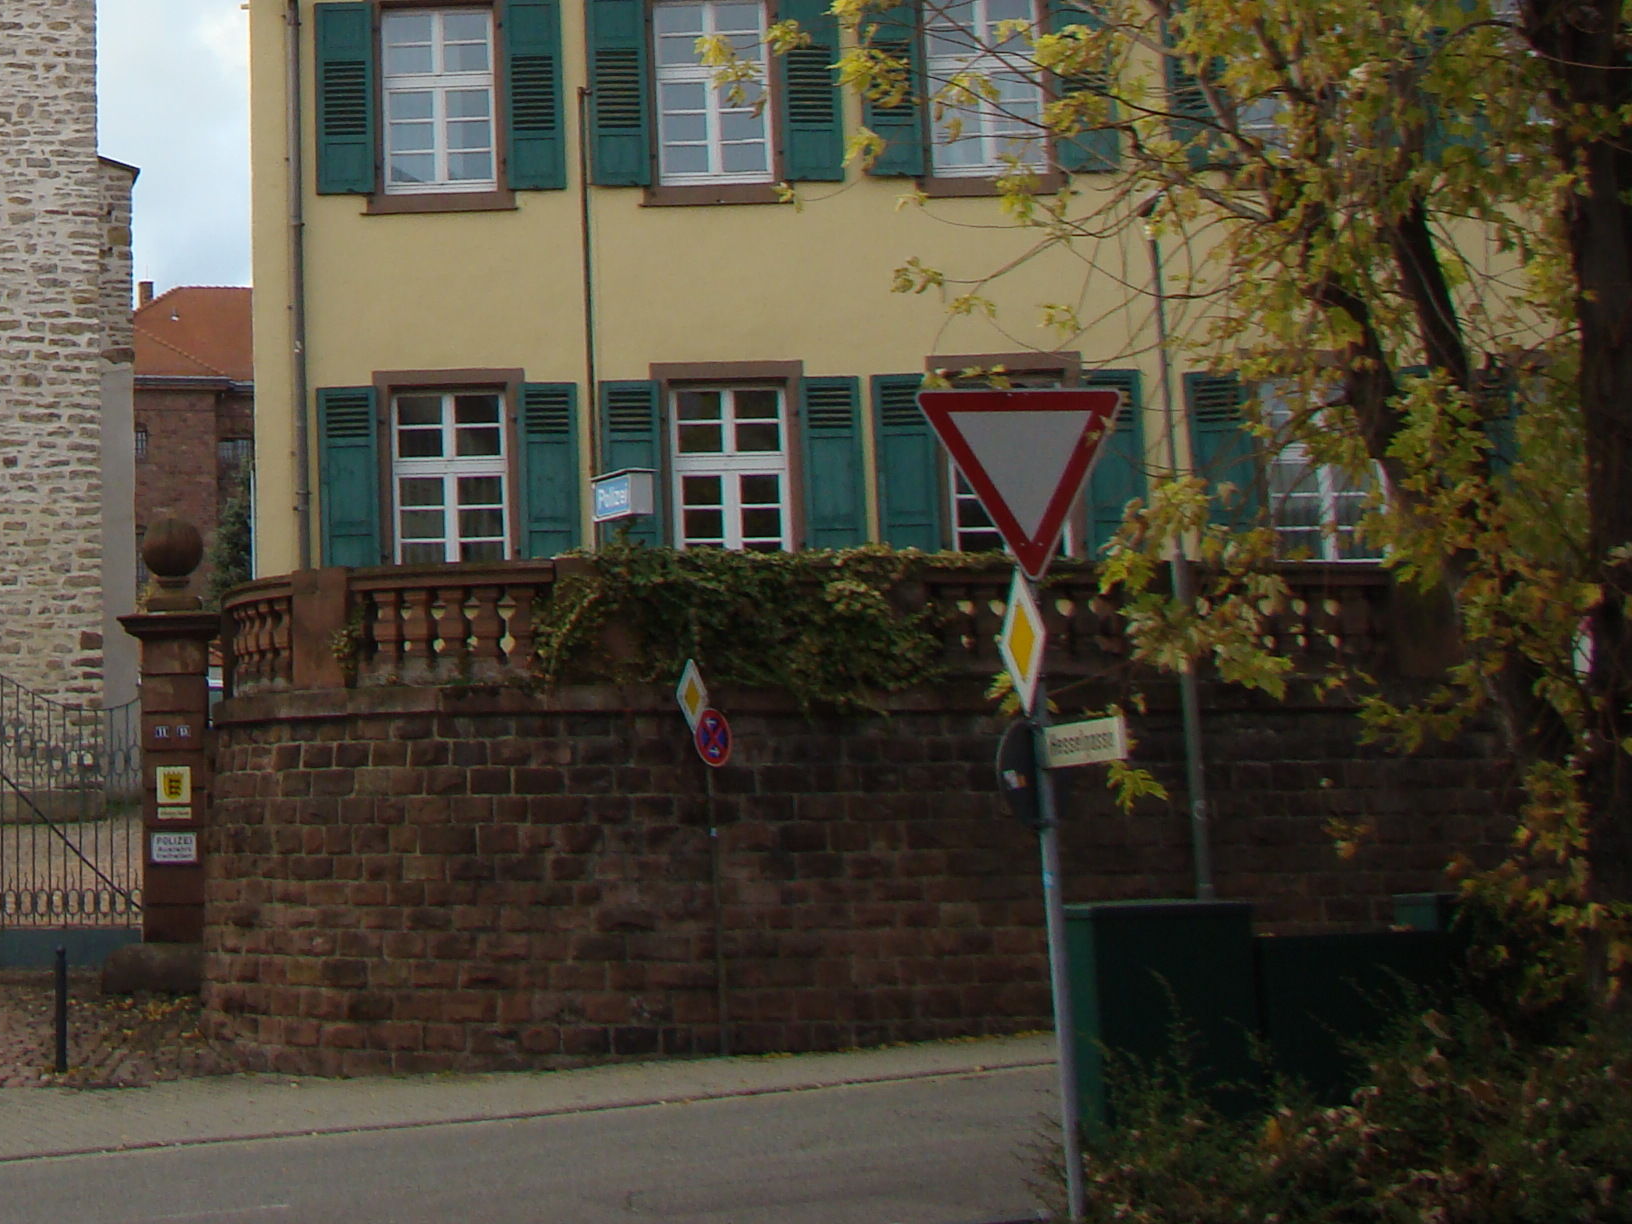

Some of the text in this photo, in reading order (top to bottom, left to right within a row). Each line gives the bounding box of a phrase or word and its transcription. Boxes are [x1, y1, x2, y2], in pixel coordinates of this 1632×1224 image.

[597, 482, 628, 509] Polizei
[1049, 729, 1114, 759] Hesselgasse
[156, 836, 193, 845] POLIZEI
